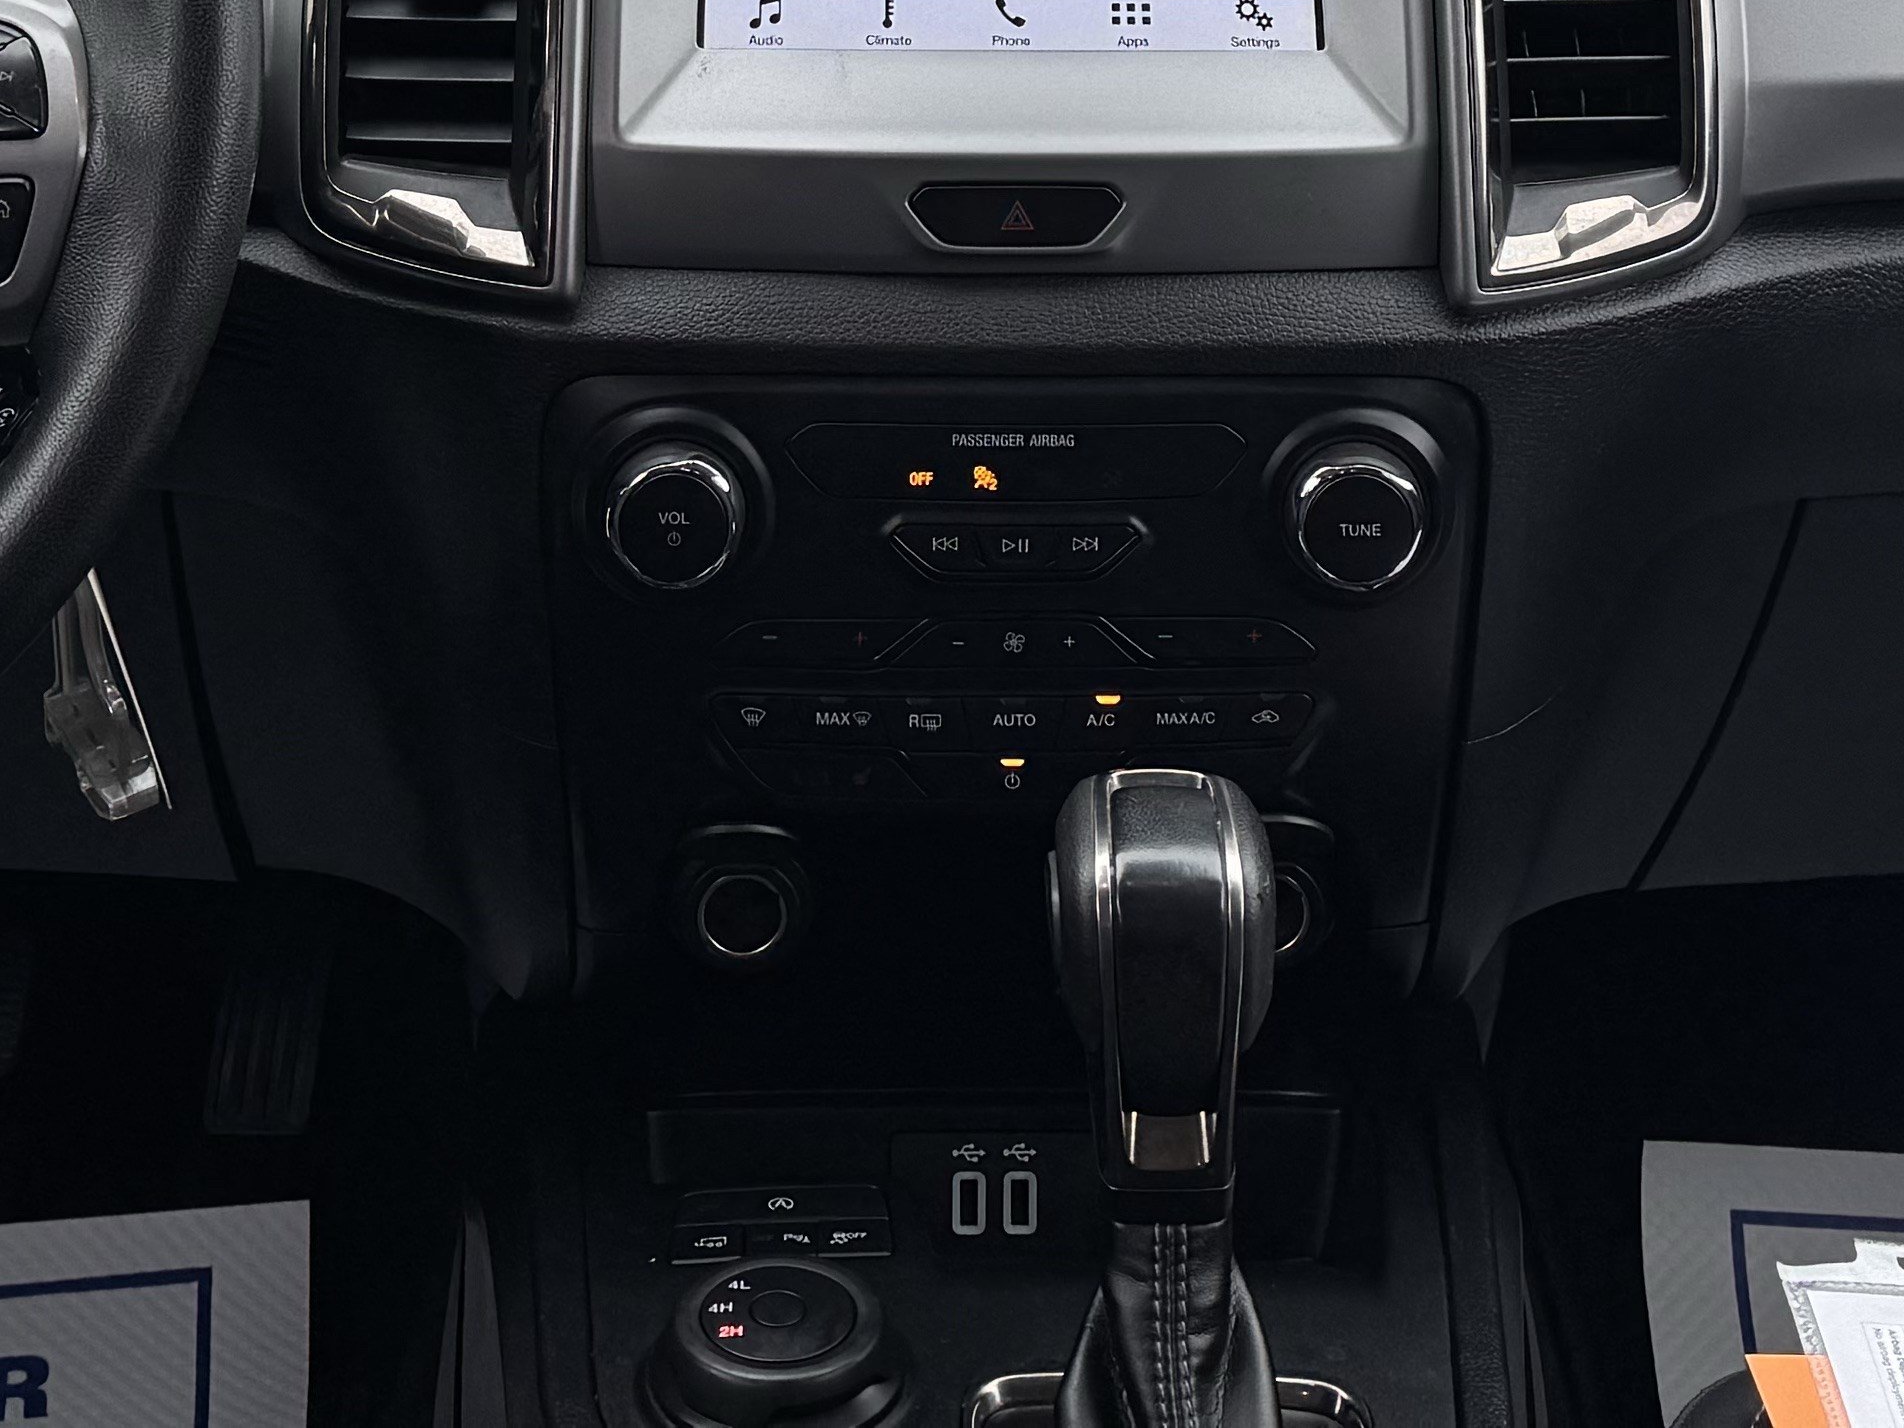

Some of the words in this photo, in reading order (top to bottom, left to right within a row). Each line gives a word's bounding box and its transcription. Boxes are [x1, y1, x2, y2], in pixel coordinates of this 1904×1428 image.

[748, 35, 784, 46] Audio
[865, 35, 913, 46] Climate
[992, 35, 1031, 46] Phone
[1117, 36, 1149, 48] Apps
[1230, 36, 1281, 48] Settings
[951, 433, 1025, 448] PASSENGER
[1029, 434, 1075, 448] AIRBAG
[908, 470, 934, 486] OFF
[658, 511, 690, 525] VOL
[1339, 523, 1382, 538] TUNE
[815, 712, 851, 726] MAX
[993, 713, 1037, 727] AUTO
[1086, 713, 1116, 728] A/C
[1156, 712, 1187, 725] MAX
[1189, 711, 1216, 725] A/C
[727, 1279, 751, 1290] 4L
[708, 1301, 734, 1313] 4H
[718, 1325, 744, 1338] 2H
